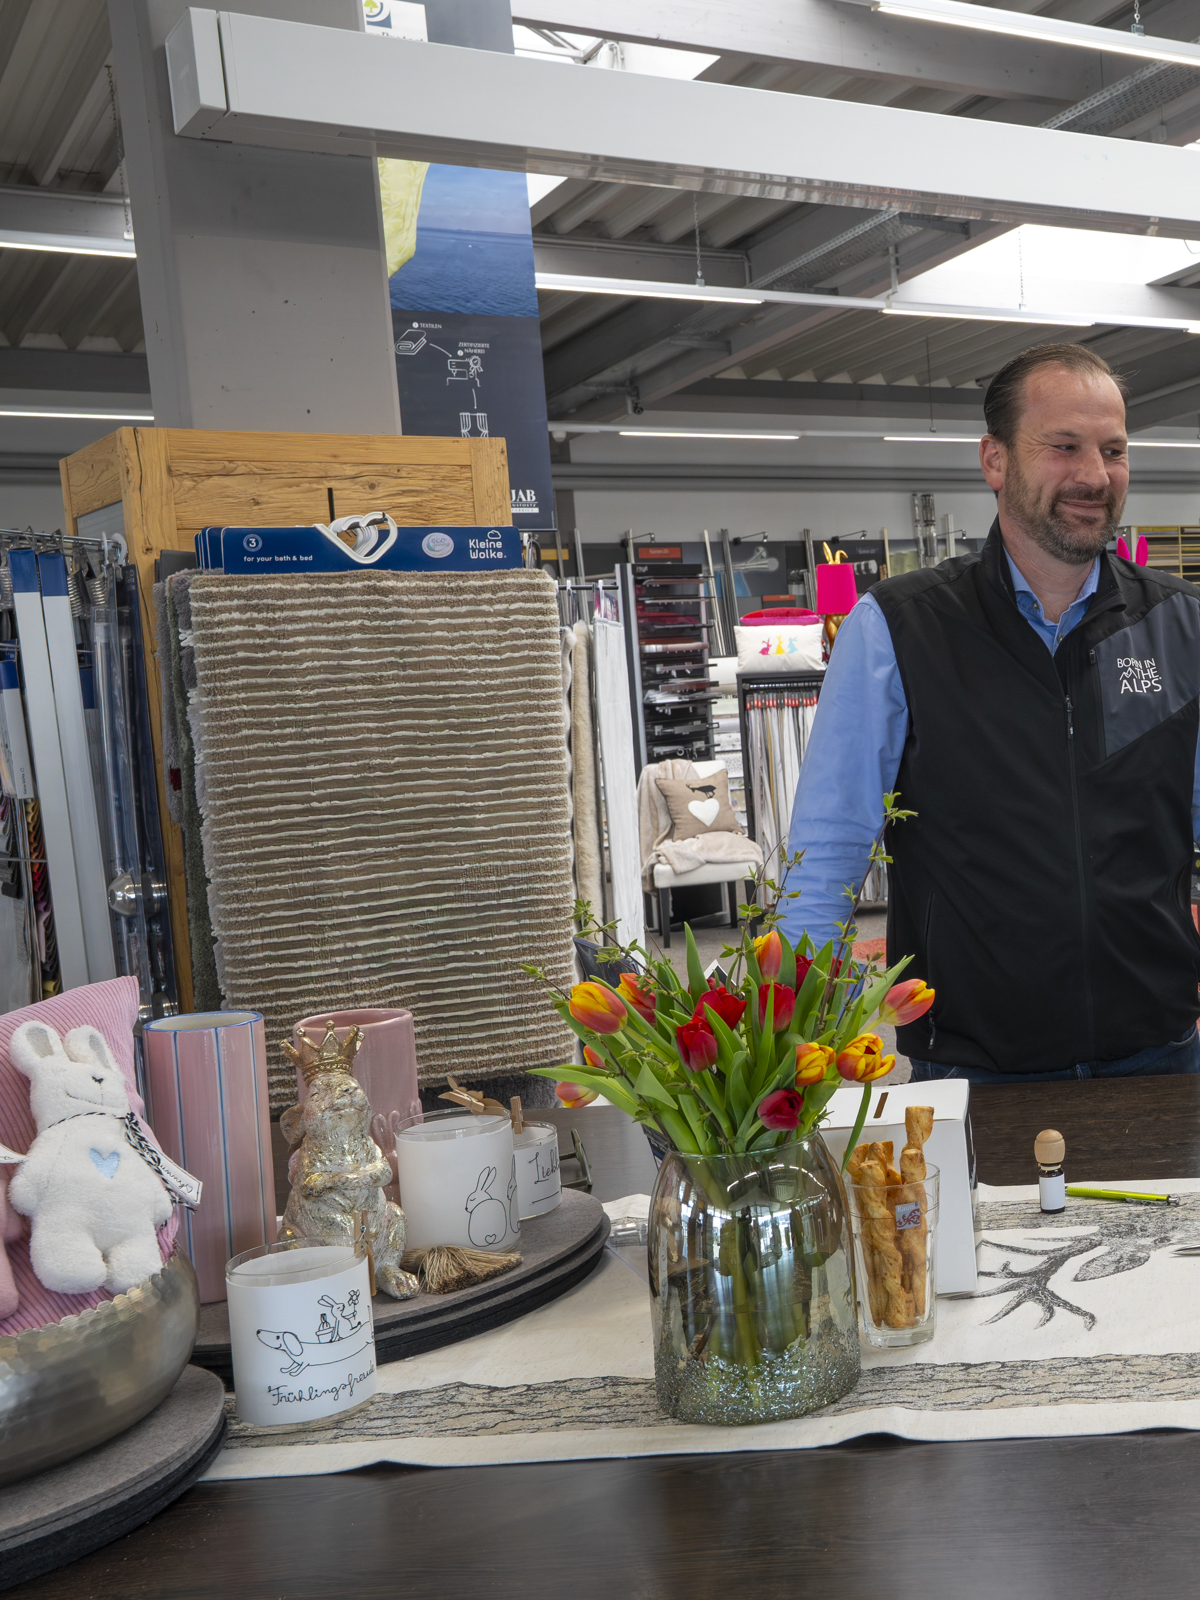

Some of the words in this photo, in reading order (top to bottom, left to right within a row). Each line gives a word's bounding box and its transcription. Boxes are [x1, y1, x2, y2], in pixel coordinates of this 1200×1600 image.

[511, 488, 537, 502] JAB
[248, 538, 257, 547] 3
[468, 539, 503, 549] Kleine
[469, 549, 504, 559] Wolke
[1116, 657, 1143, 669] BORN
[1143, 657, 1156, 669] IN
[1135, 666, 1160, 680] THE
[1120, 678, 1162, 694] ALPS
